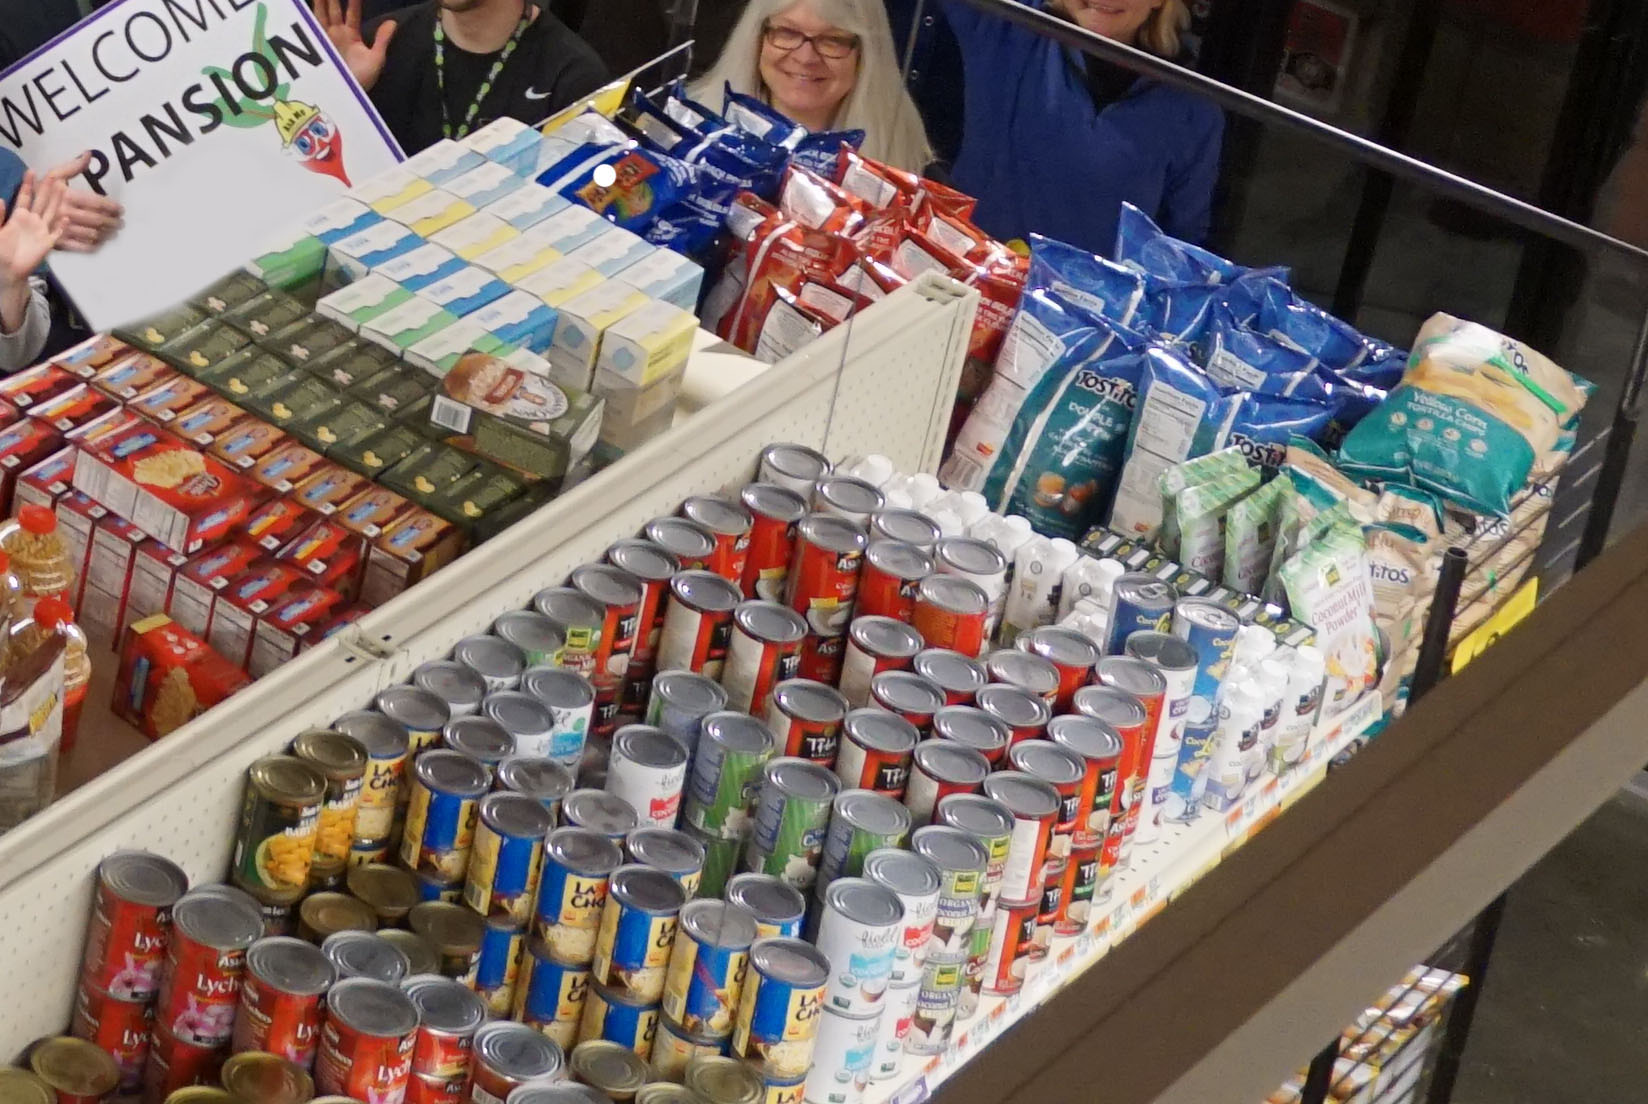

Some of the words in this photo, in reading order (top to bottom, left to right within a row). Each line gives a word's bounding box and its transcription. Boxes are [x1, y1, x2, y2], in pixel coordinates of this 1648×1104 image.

[84, 20, 324, 197] PANSION
[1324, 606, 1361, 636] Powder
[806, 735, 838, 754] THA
[369, 773, 402, 793] CHO
[573, 880, 595, 897] LA
[571, 894, 607, 910] CHO
[133, 933, 165, 951] Lyc
[196, 973, 243, 996] Lych
[800, 995, 820, 1008] LA
